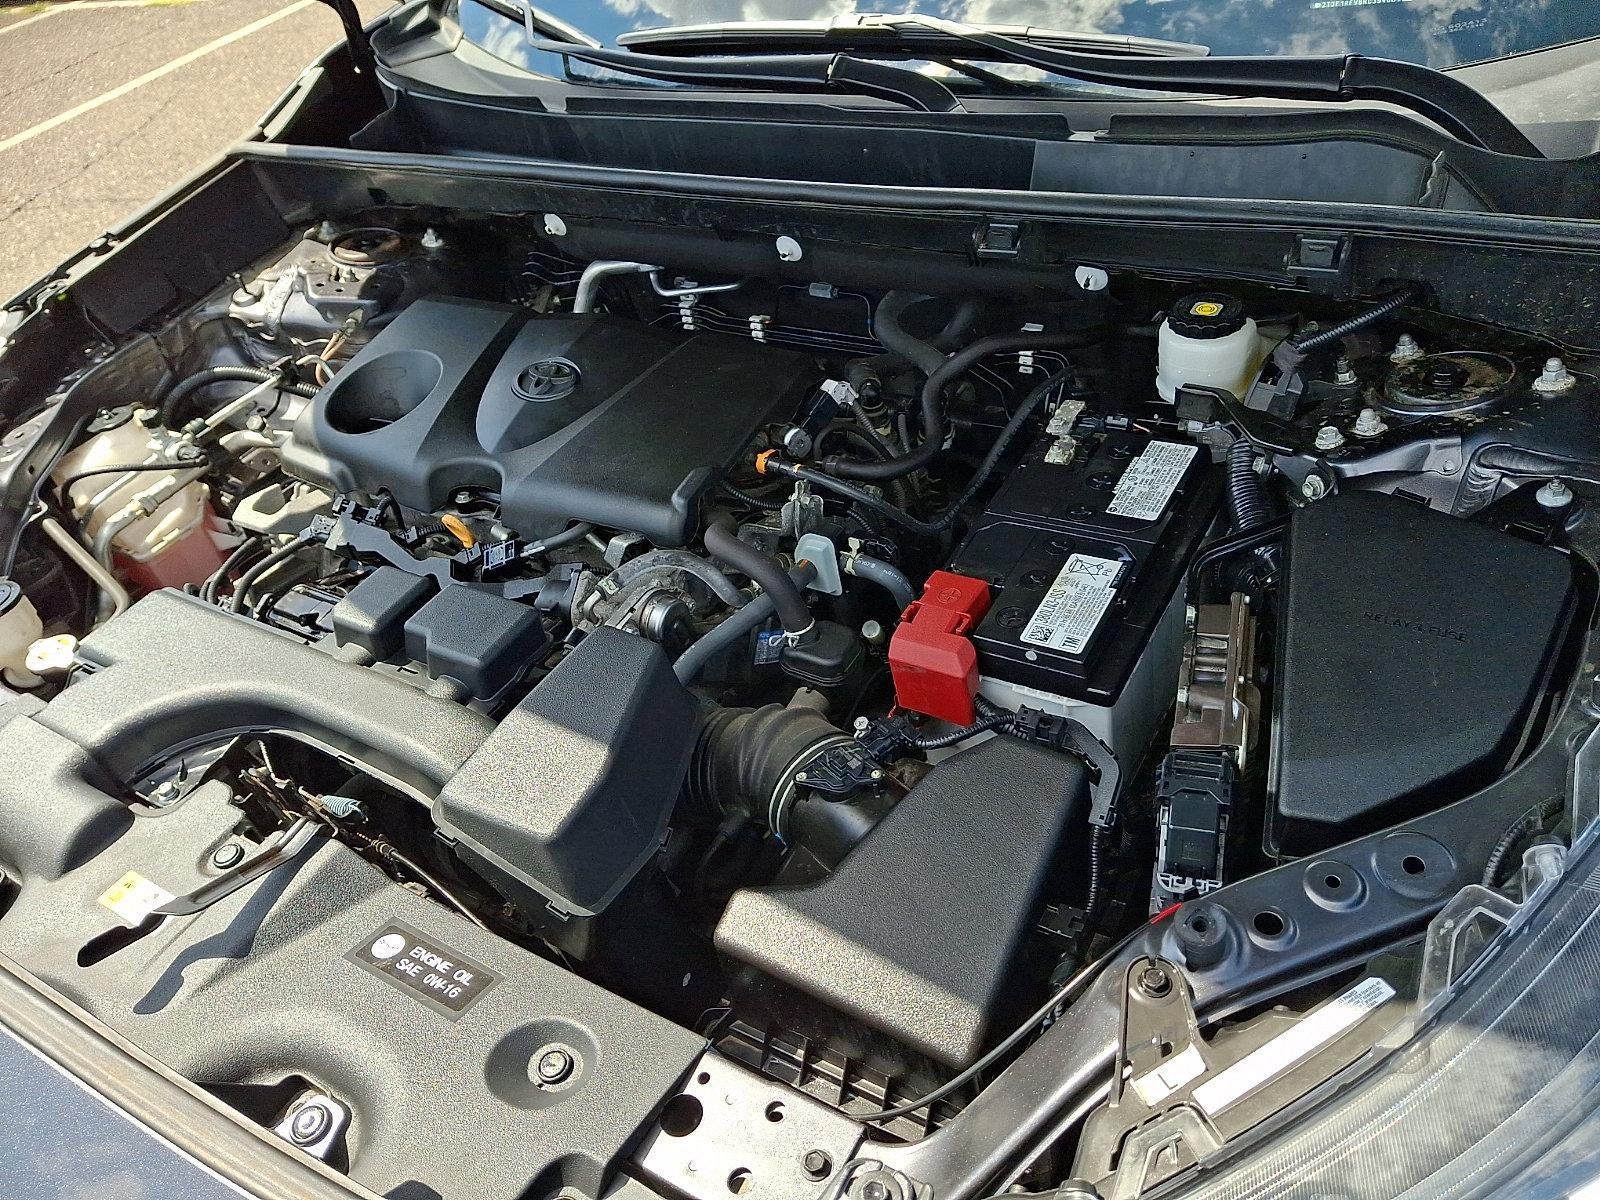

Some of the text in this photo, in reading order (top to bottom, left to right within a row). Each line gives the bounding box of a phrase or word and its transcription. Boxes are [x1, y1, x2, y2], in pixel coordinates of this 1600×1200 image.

[1363, 611, 1468, 643] RELAY & FUSE
[395, 958, 462, 998] SAE 0W-16
[409, 945, 453, 974] ENGINE
[453, 969, 474, 986] OIL
